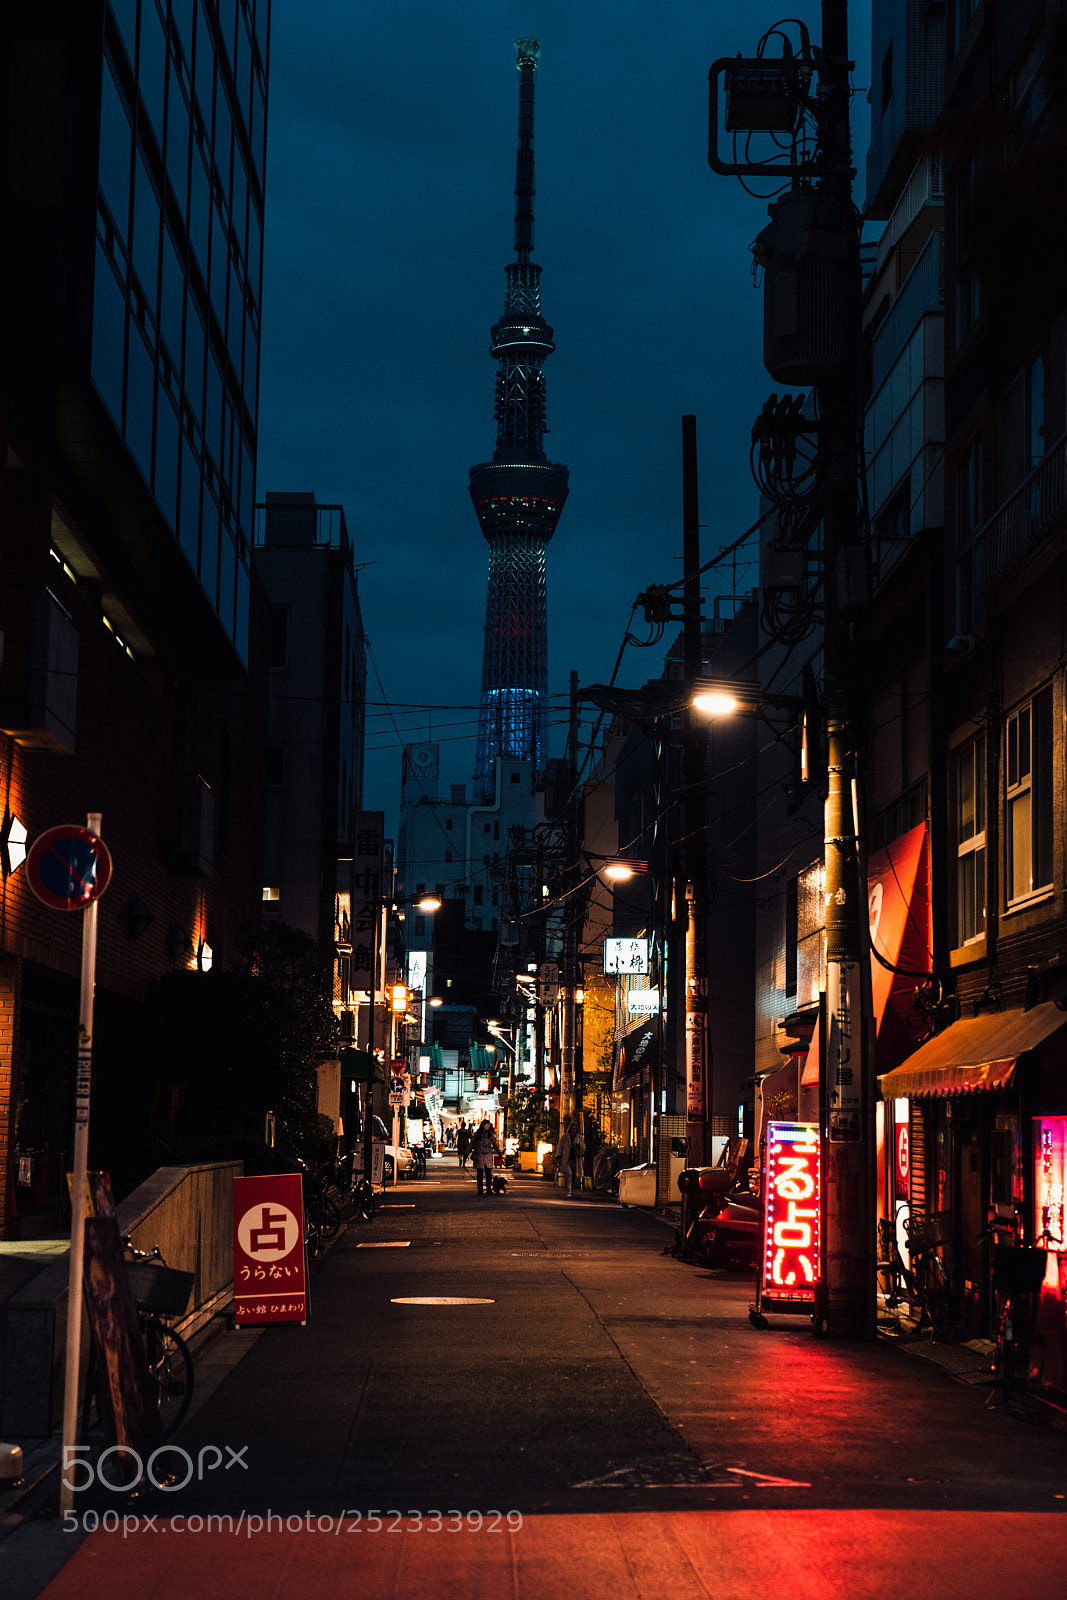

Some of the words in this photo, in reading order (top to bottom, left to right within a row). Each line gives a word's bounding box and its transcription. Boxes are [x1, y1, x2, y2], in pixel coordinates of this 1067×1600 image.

[836, 1008, 853, 1086] ミドリ屋
[250, 1207, 287, 1253] 占
[240, 1264, 299, 1281] うらない
